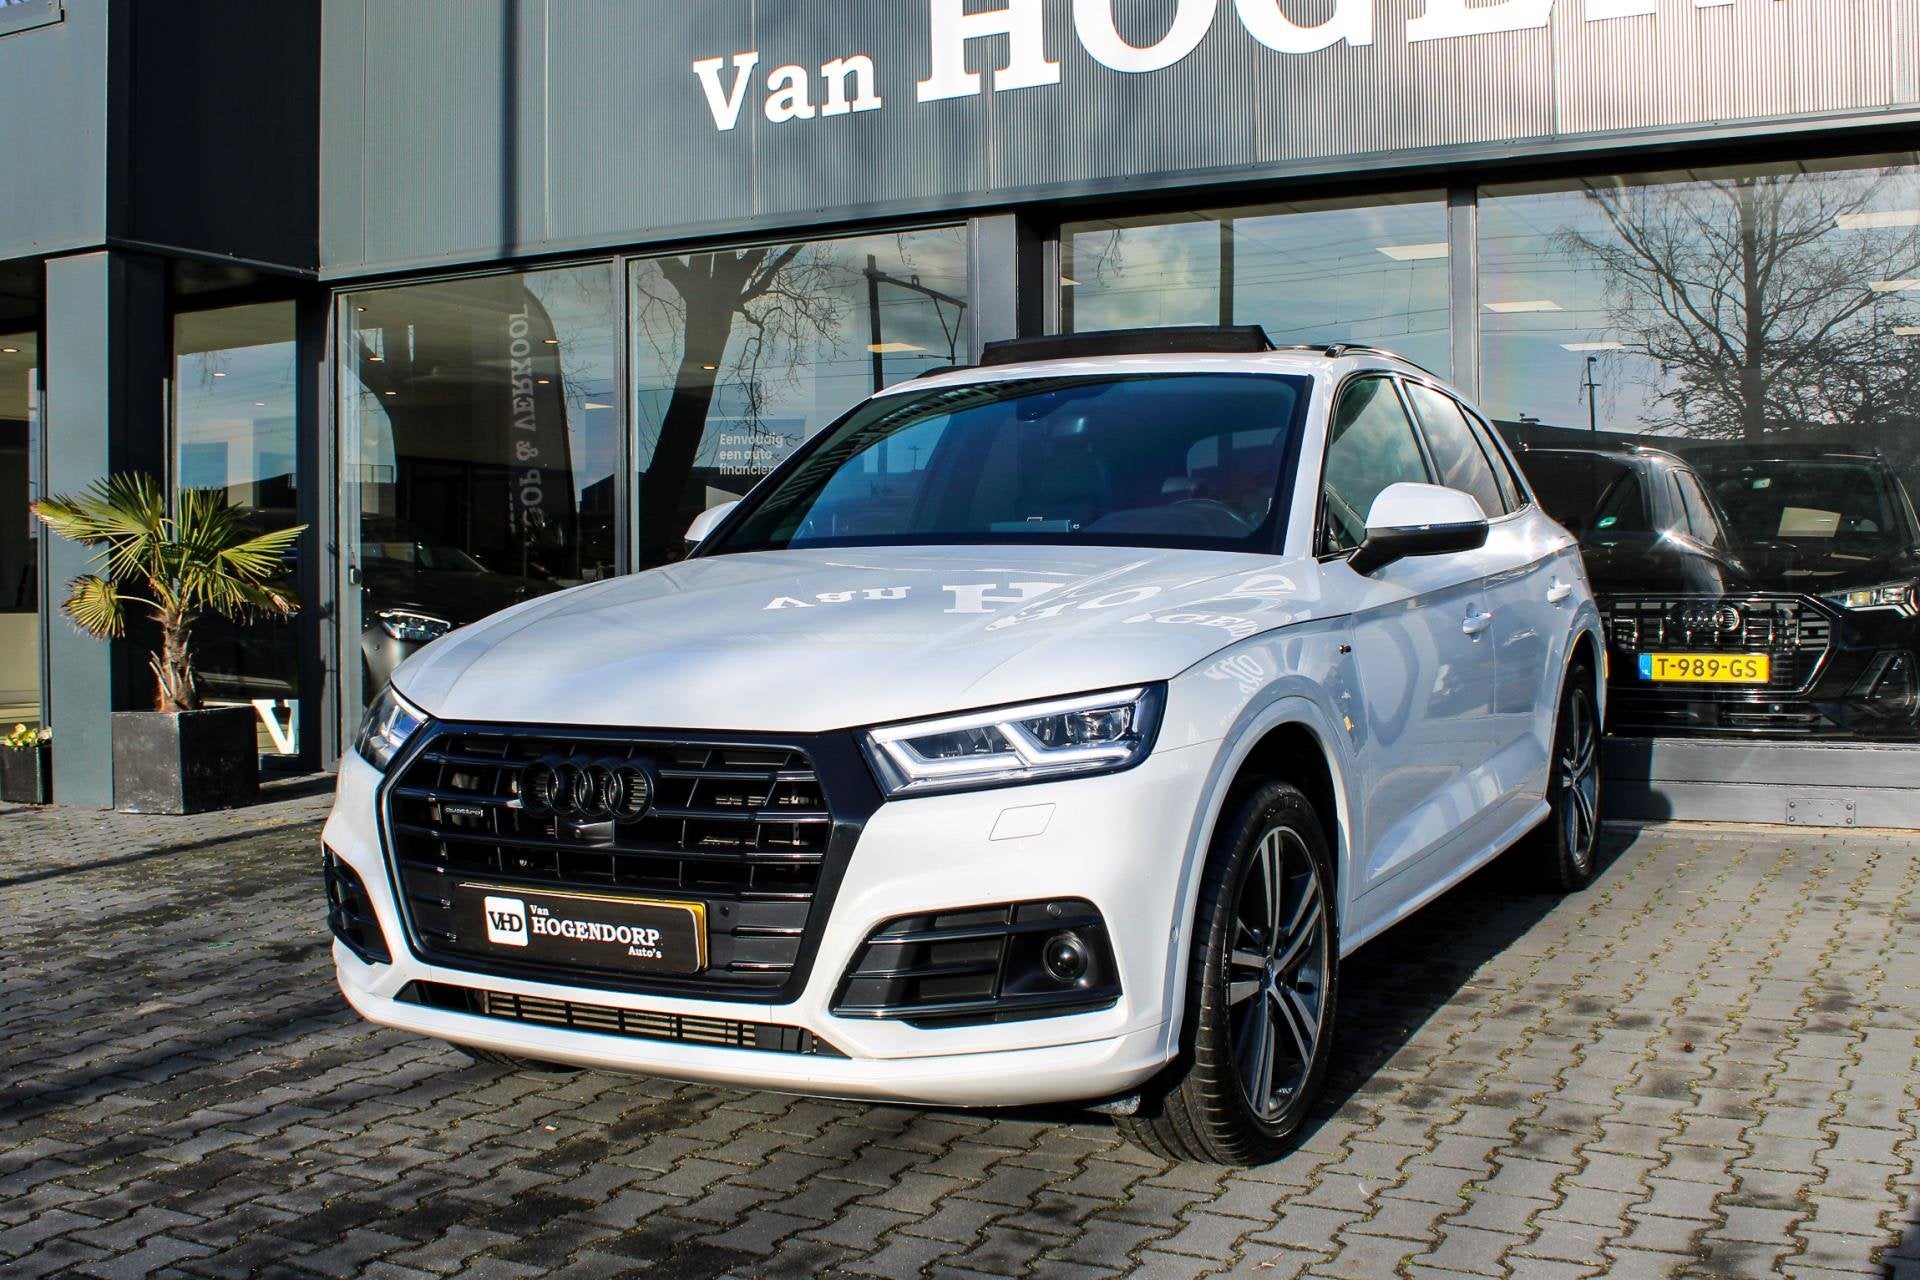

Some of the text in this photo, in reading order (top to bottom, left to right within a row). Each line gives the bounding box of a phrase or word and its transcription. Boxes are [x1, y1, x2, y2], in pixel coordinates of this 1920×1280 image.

[693, 51, 882, 132] Van
[720, 433, 783, 447] Eenvoudig
[719, 450, 773, 460] een auto
[1657, 658, 1758, 678] T-989-GS
[530, 904, 549, 916] Van
[488, 911, 523, 932] VHD
[531, 917, 660, 946] HOGENDORP
[628, 946, 662, 958] Auto's
